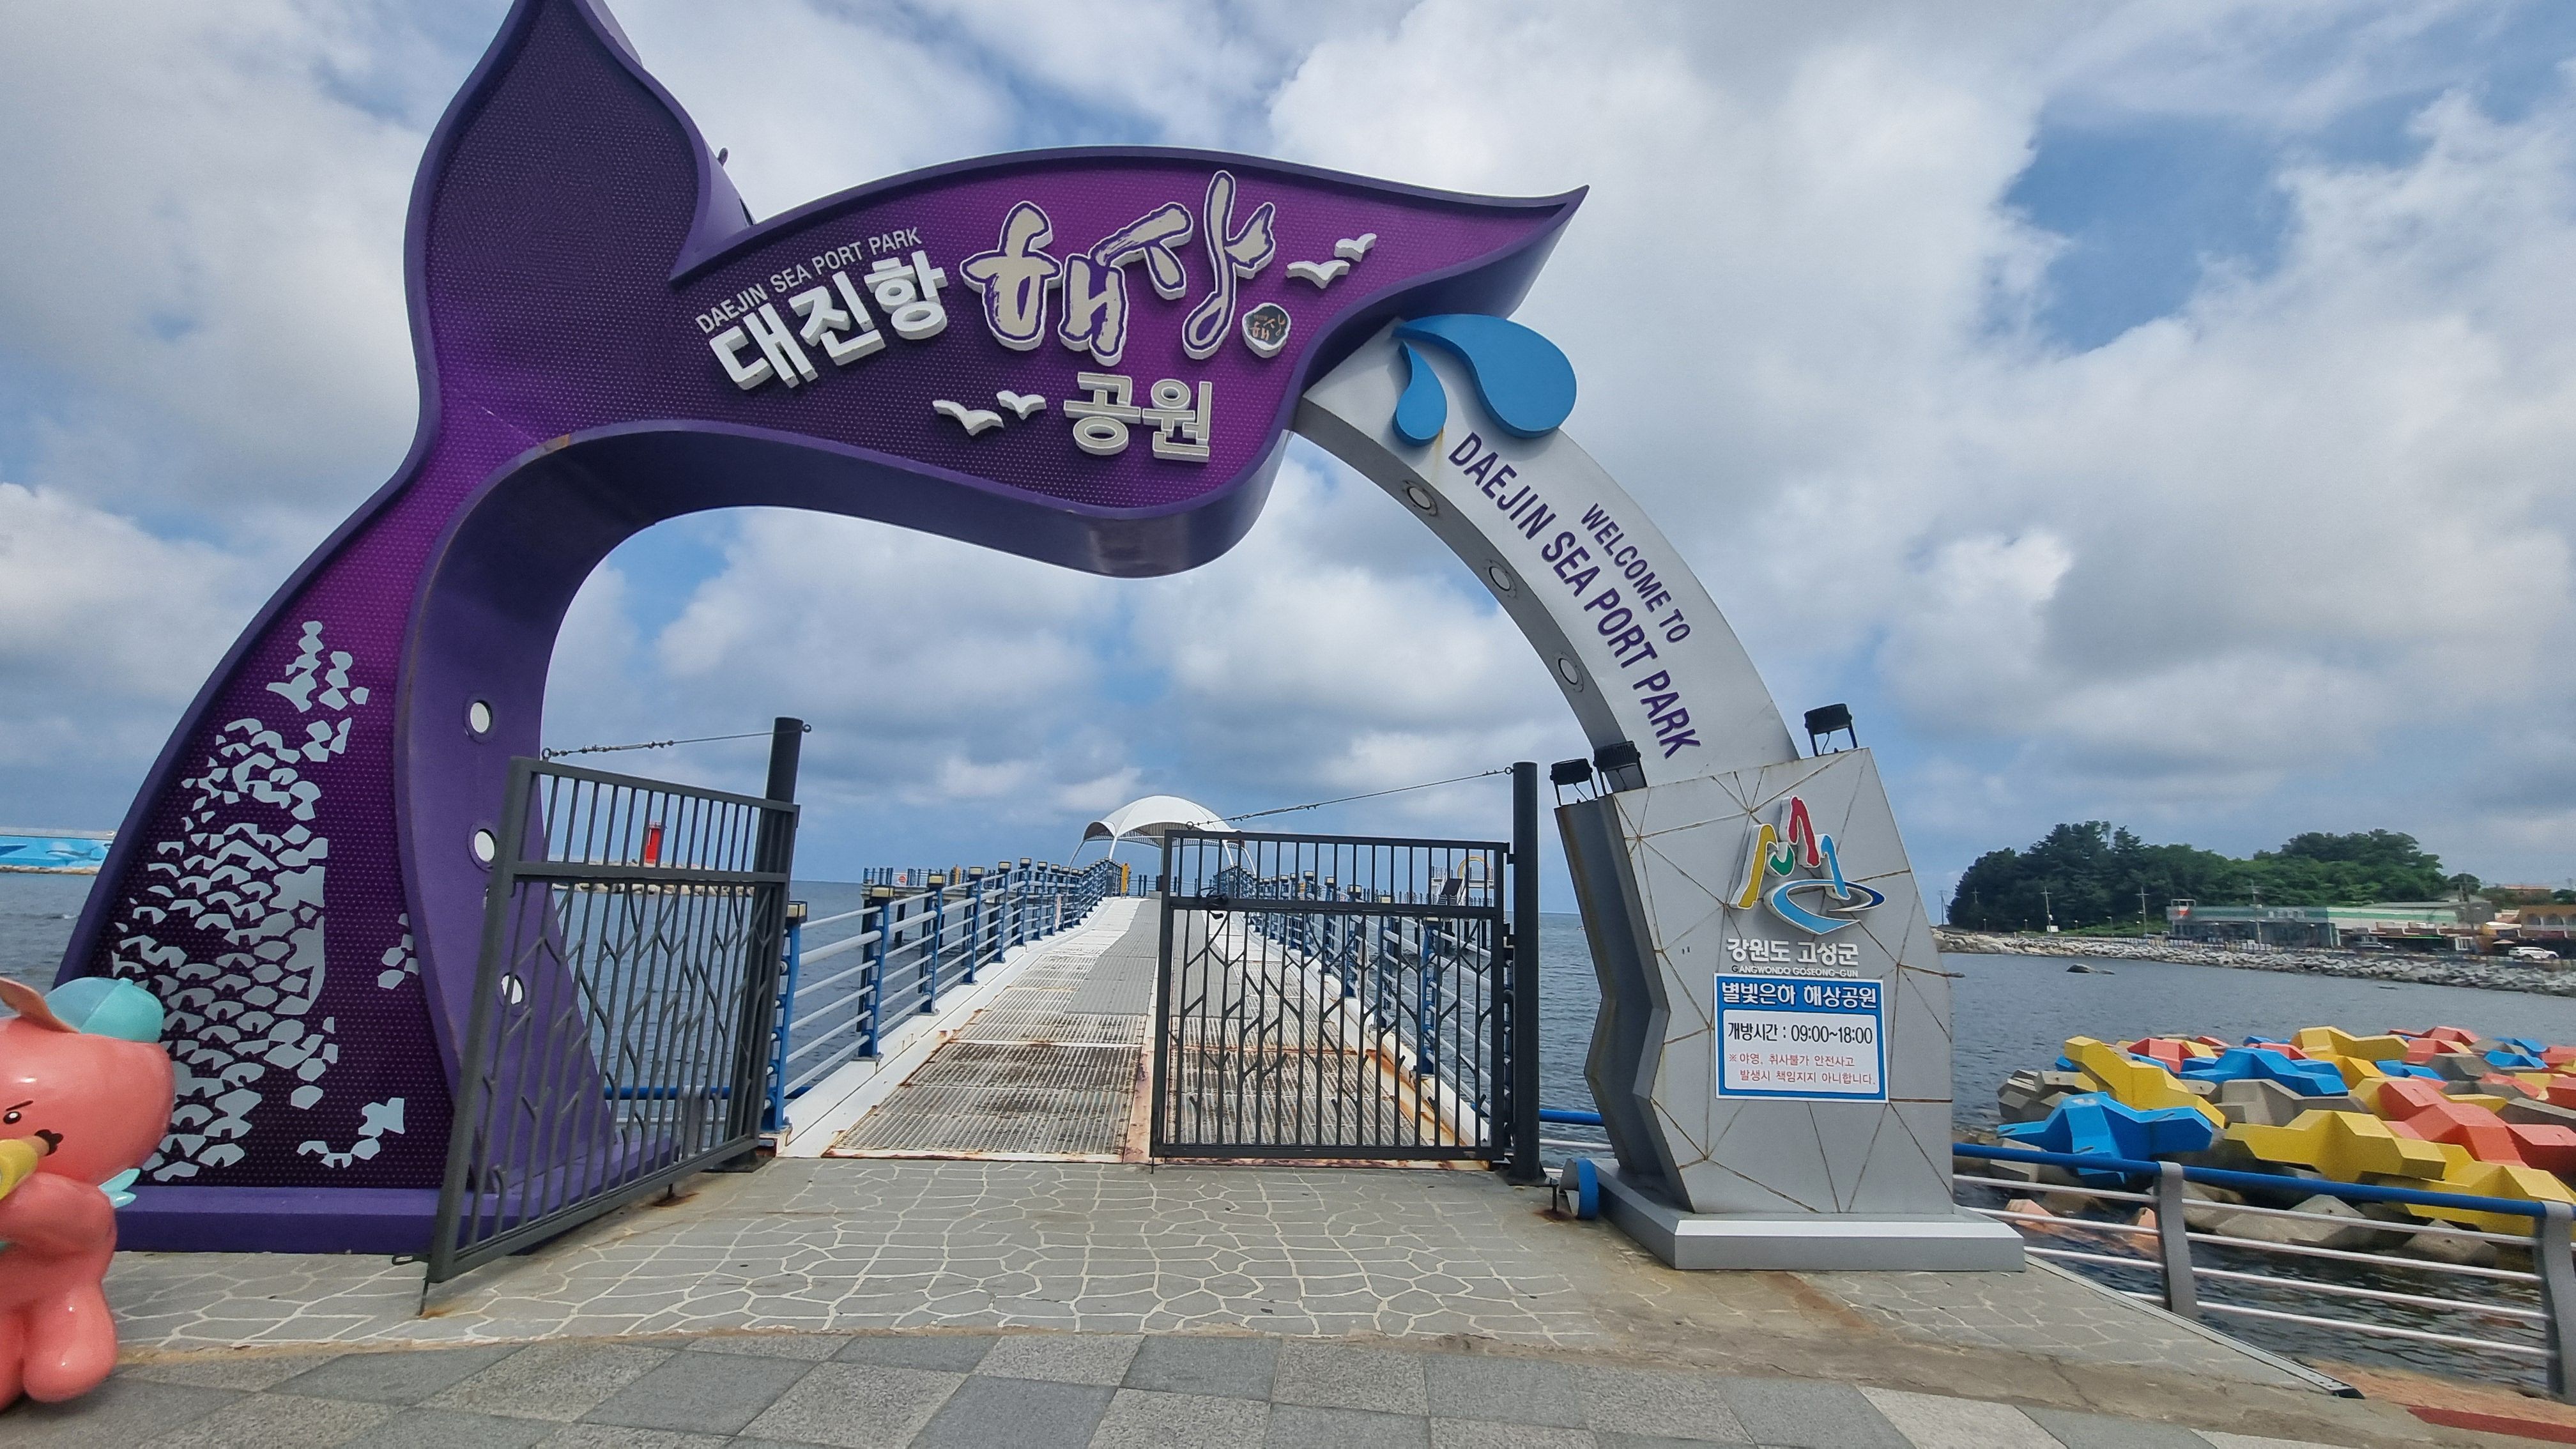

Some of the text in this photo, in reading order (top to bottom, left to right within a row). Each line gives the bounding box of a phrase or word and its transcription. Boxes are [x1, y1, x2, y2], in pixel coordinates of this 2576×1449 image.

[695, 227, 922, 334] DAEJIN SEA PORT PARK
[709, 170, 1275, 390] 대진항 해상
[1063, 372, 1213, 463] 공원
[1580, 503, 1690, 643] WELCOME TO
[1448, 432, 1701, 759] DAEJIN SEA PORT PARK
[1727, 938, 1859, 966] 강원도 고성군
[1731, 965, 1790, 975] GANGWONDO
[1722, 981, 1876, 1009] 별빛은하 해상공원
[1728, 1022, 1778, 1041] 개방시간
[1791, 1024, 1873, 1045] 09:00~18:00
[1768, 1054, 1809, 1066] 취사불가
[1814, 1055, 1855, 1067] 안전사고
[1740, 1070, 1876, 1085] 발생시 책임지지 아니합니다.
